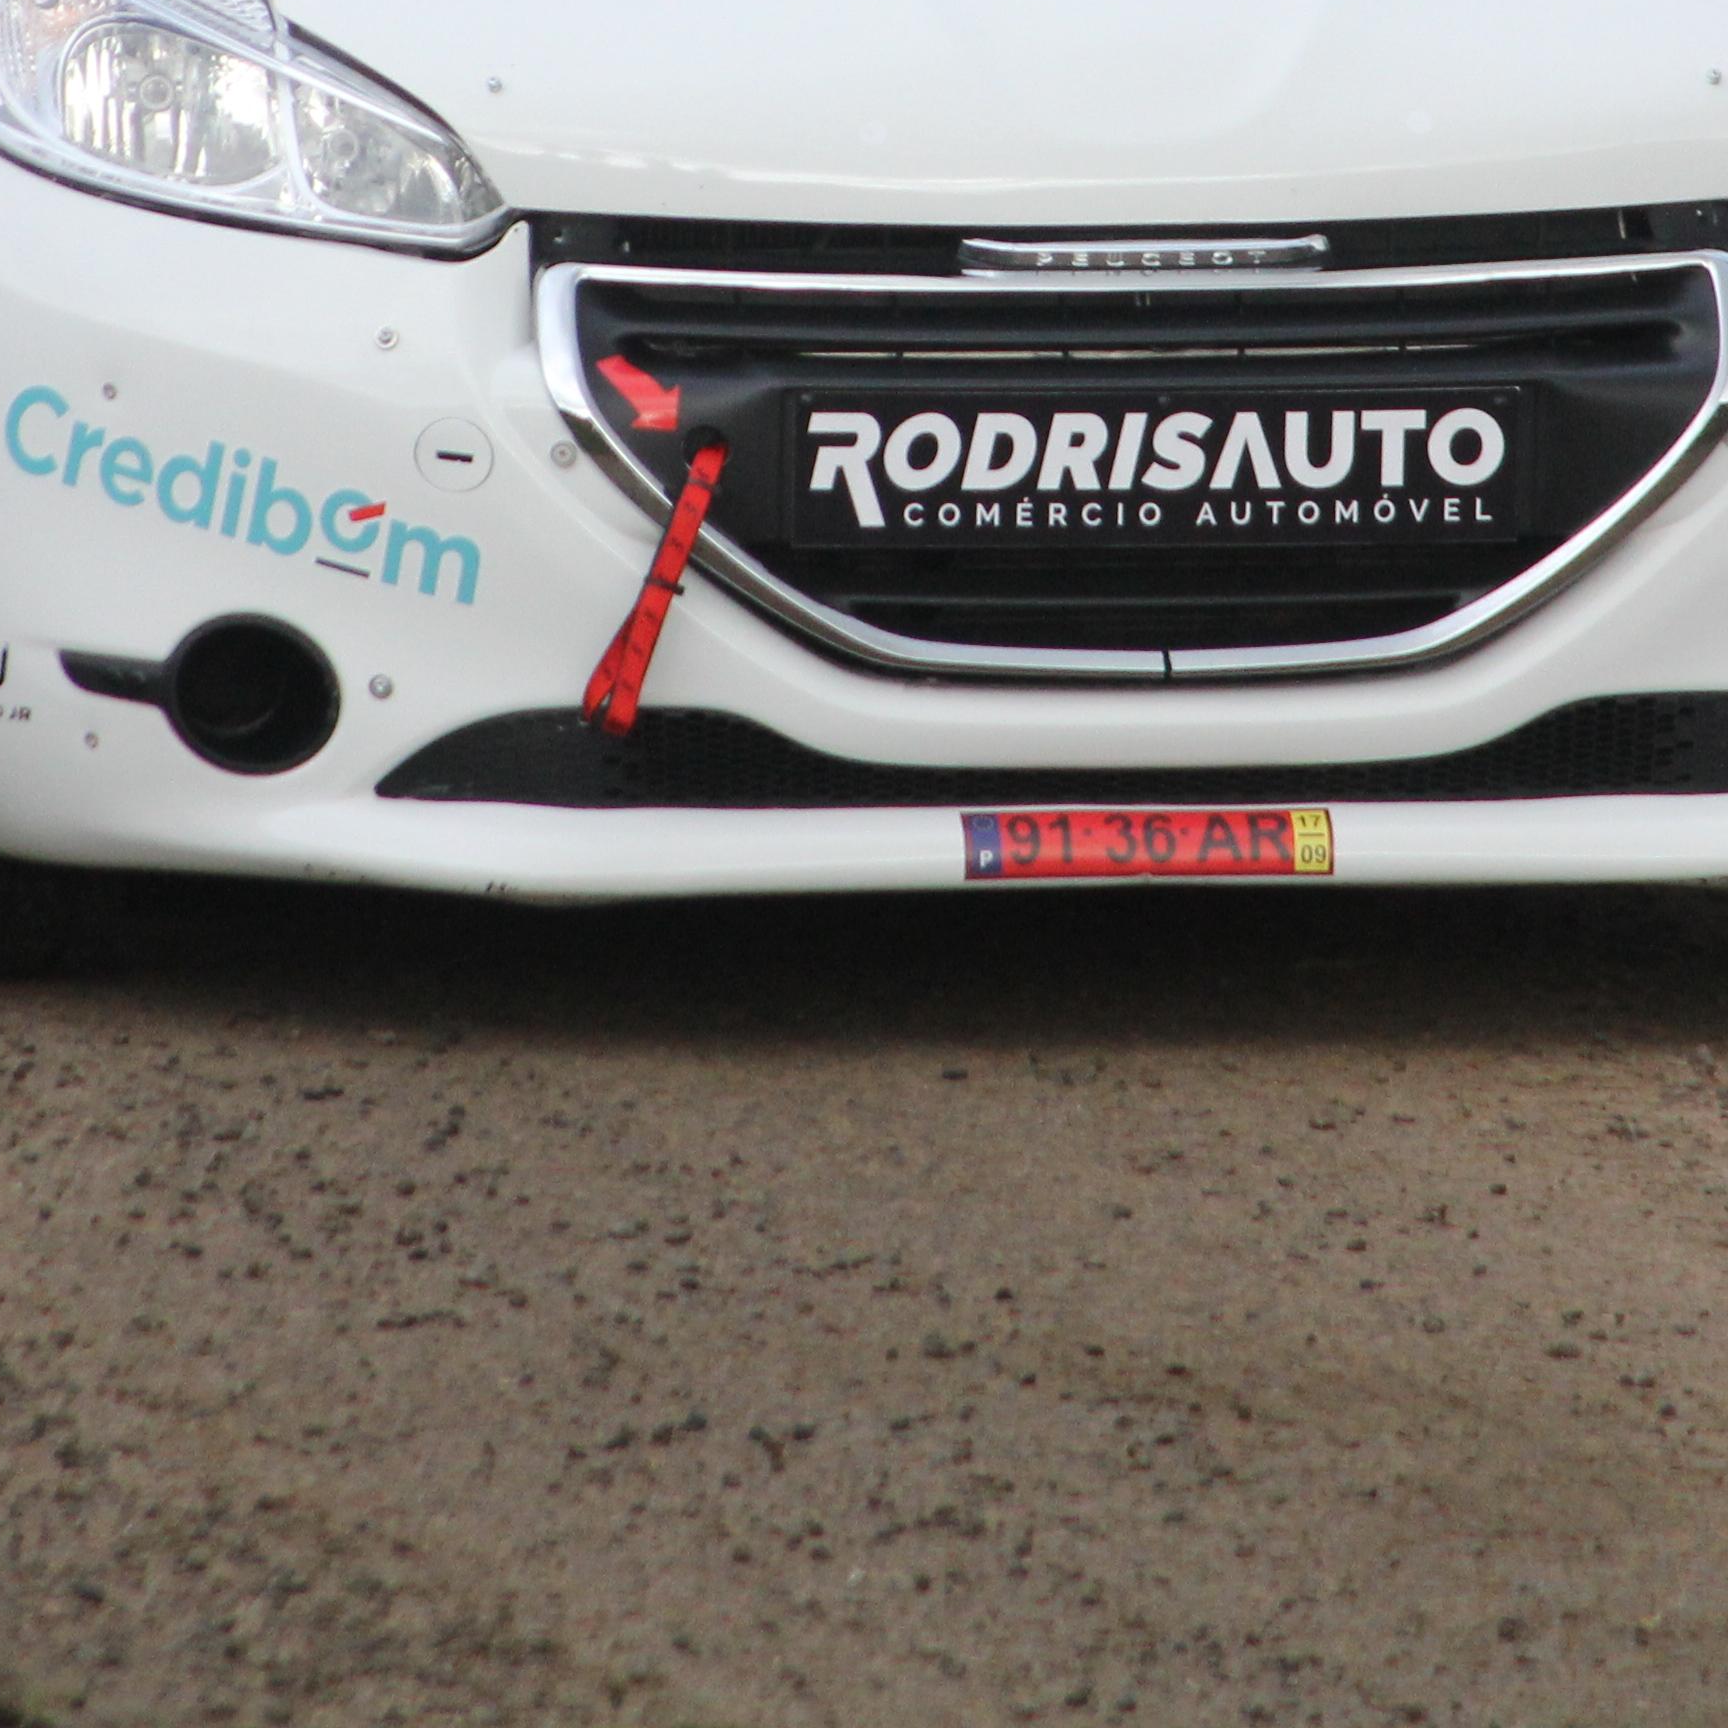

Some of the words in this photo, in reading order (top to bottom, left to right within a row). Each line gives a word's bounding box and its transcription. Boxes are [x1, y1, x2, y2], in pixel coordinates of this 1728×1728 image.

[1035, 250, 1266, 268] PEUGEOT
[806, 407, 1506, 528] RODRISAUTO
[4, 384, 482, 605] Credibom
[903, 494, 1163, 528] COMÉRCIO
[1195, 494, 1493, 525] AUTOMÓVEL
[980, 849, 993, 868] P
[1299, 843, 1327, 865] 09
